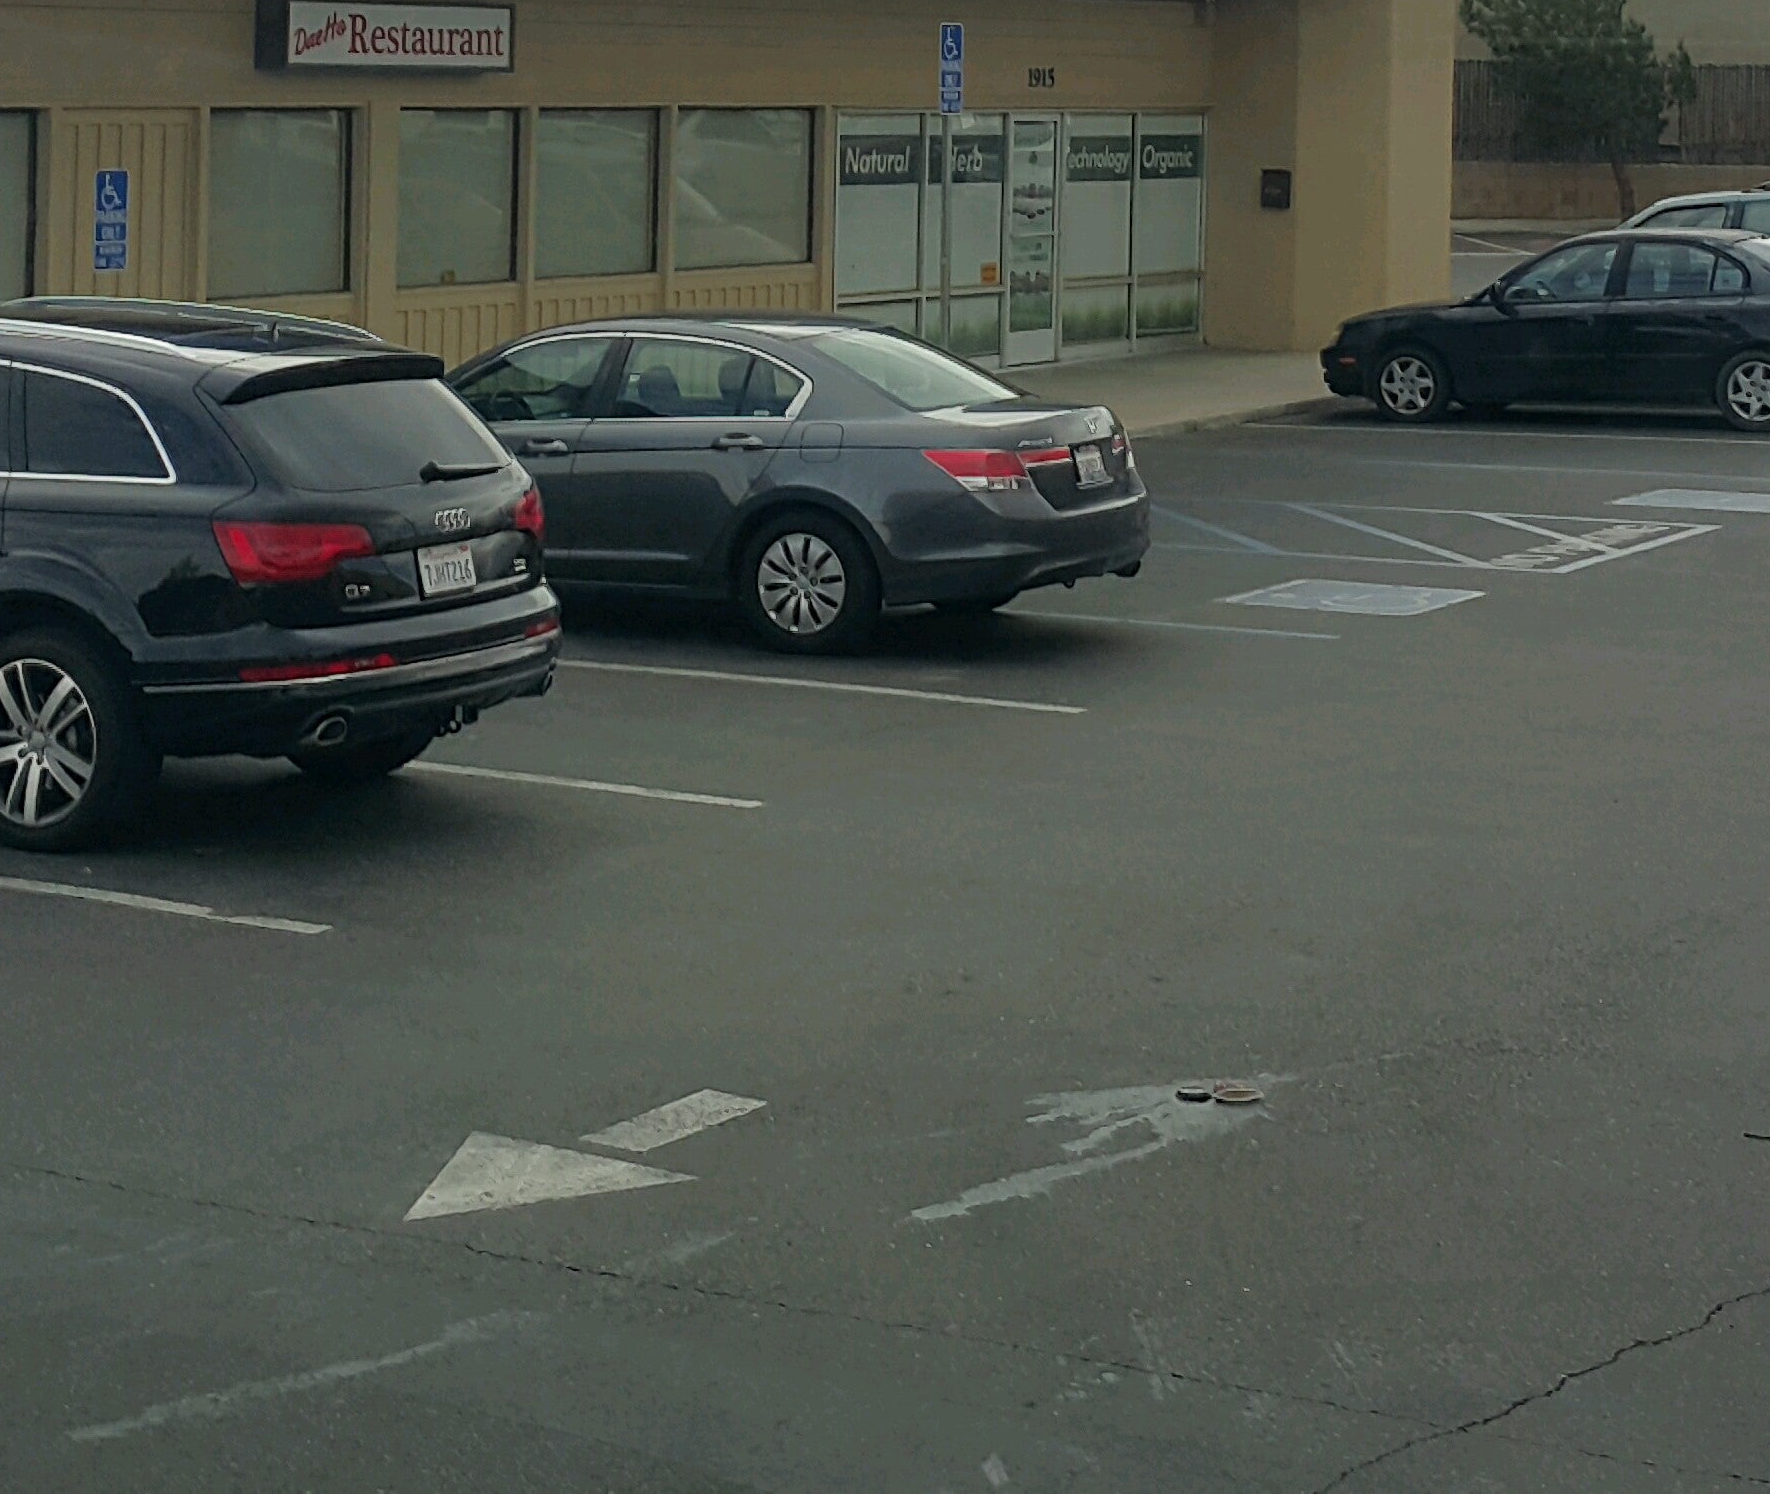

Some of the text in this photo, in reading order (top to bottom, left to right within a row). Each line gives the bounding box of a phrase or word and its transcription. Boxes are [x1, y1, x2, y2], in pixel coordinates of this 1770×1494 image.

[347, 14, 505, 56] Restaurant
[845, 145, 911, 174] Natural
[1066, 144, 1130, 175] echnology
[1142, 143, 1193, 174] Organic
